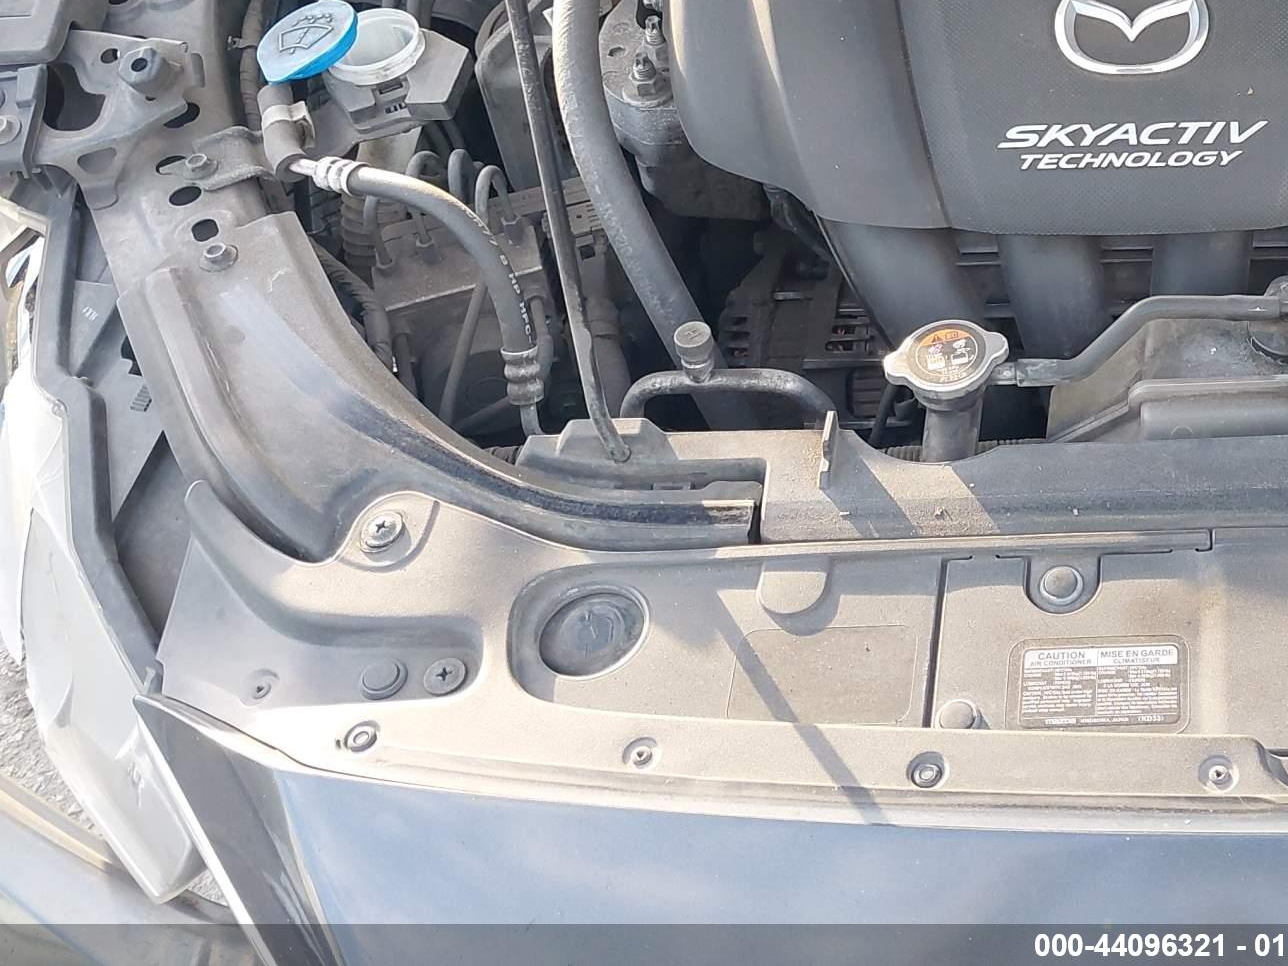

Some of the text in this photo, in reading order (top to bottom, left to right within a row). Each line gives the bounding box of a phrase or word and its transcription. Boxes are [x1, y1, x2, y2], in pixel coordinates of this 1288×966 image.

[997, 120, 1268, 149] SKYACTIV
[1020, 150, 1243, 170] TECHNOLOGY
[1038, 651, 1085, 661] CAUTION
[1100, 649, 1174, 659] MISE EN GARDE
[1043, 659, 1092, 667] CONDITIONER
[1113, 657, 1160, 665] CLIMATISEUR
